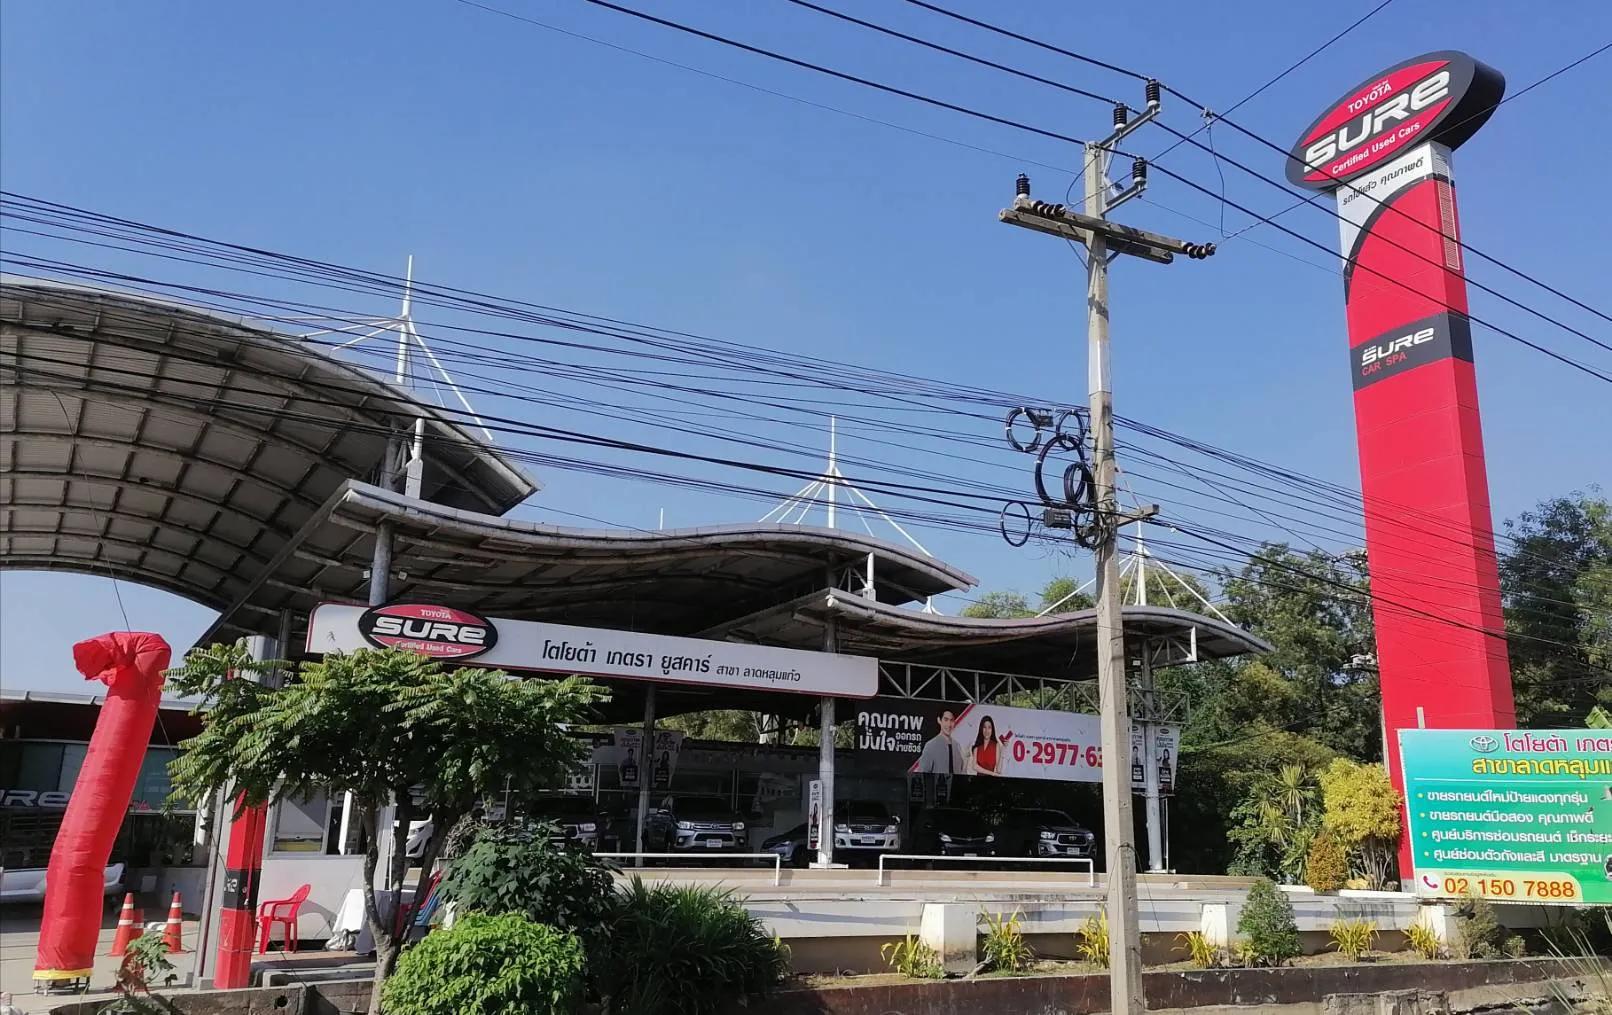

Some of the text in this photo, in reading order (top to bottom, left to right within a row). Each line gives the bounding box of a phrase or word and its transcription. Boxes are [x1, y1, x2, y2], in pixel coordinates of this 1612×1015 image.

[1348, 83, 1392, 113] TOYOTA
[1304, 71, 1450, 173] SURE
[1332, 122, 1421, 174] Certified Used Cars
[1361, 327, 1434, 366] SURE
[1361, 351, 1408, 376] CAR SPA
[421, 608, 452, 620] TOYOTA
[372, 616, 487, 645] SURE
[426, 643, 445, 652] Used
[446, 645, 463, 654] Cars
[542, 640, 597, 663] โตโยต้า
[661, 654, 712, 675] ยูสคาร์
[716, 665, 740, 677] สาขา
[743, 667, 801, 683] ลาดหลุมแก้ว
[858, 711, 924, 731] คุณภาพ
[860, 728, 896, 752] มั่นใจ
[895, 732, 922, 741] ออกรถ
[1504, 733, 1612, 752] โตโยต้า เภต
[1427, 789, 1588, 807] ขายรถยนต์ใหม่ป้ายแดงทุกรุ่น
[1430, 810, 1594, 826] ขายรถยนต์มือสอง คุณภาพดี
[1550, 853, 1602, 866] มาตรฐาน
[1444, 878, 1575, 898] 02 150 7888
